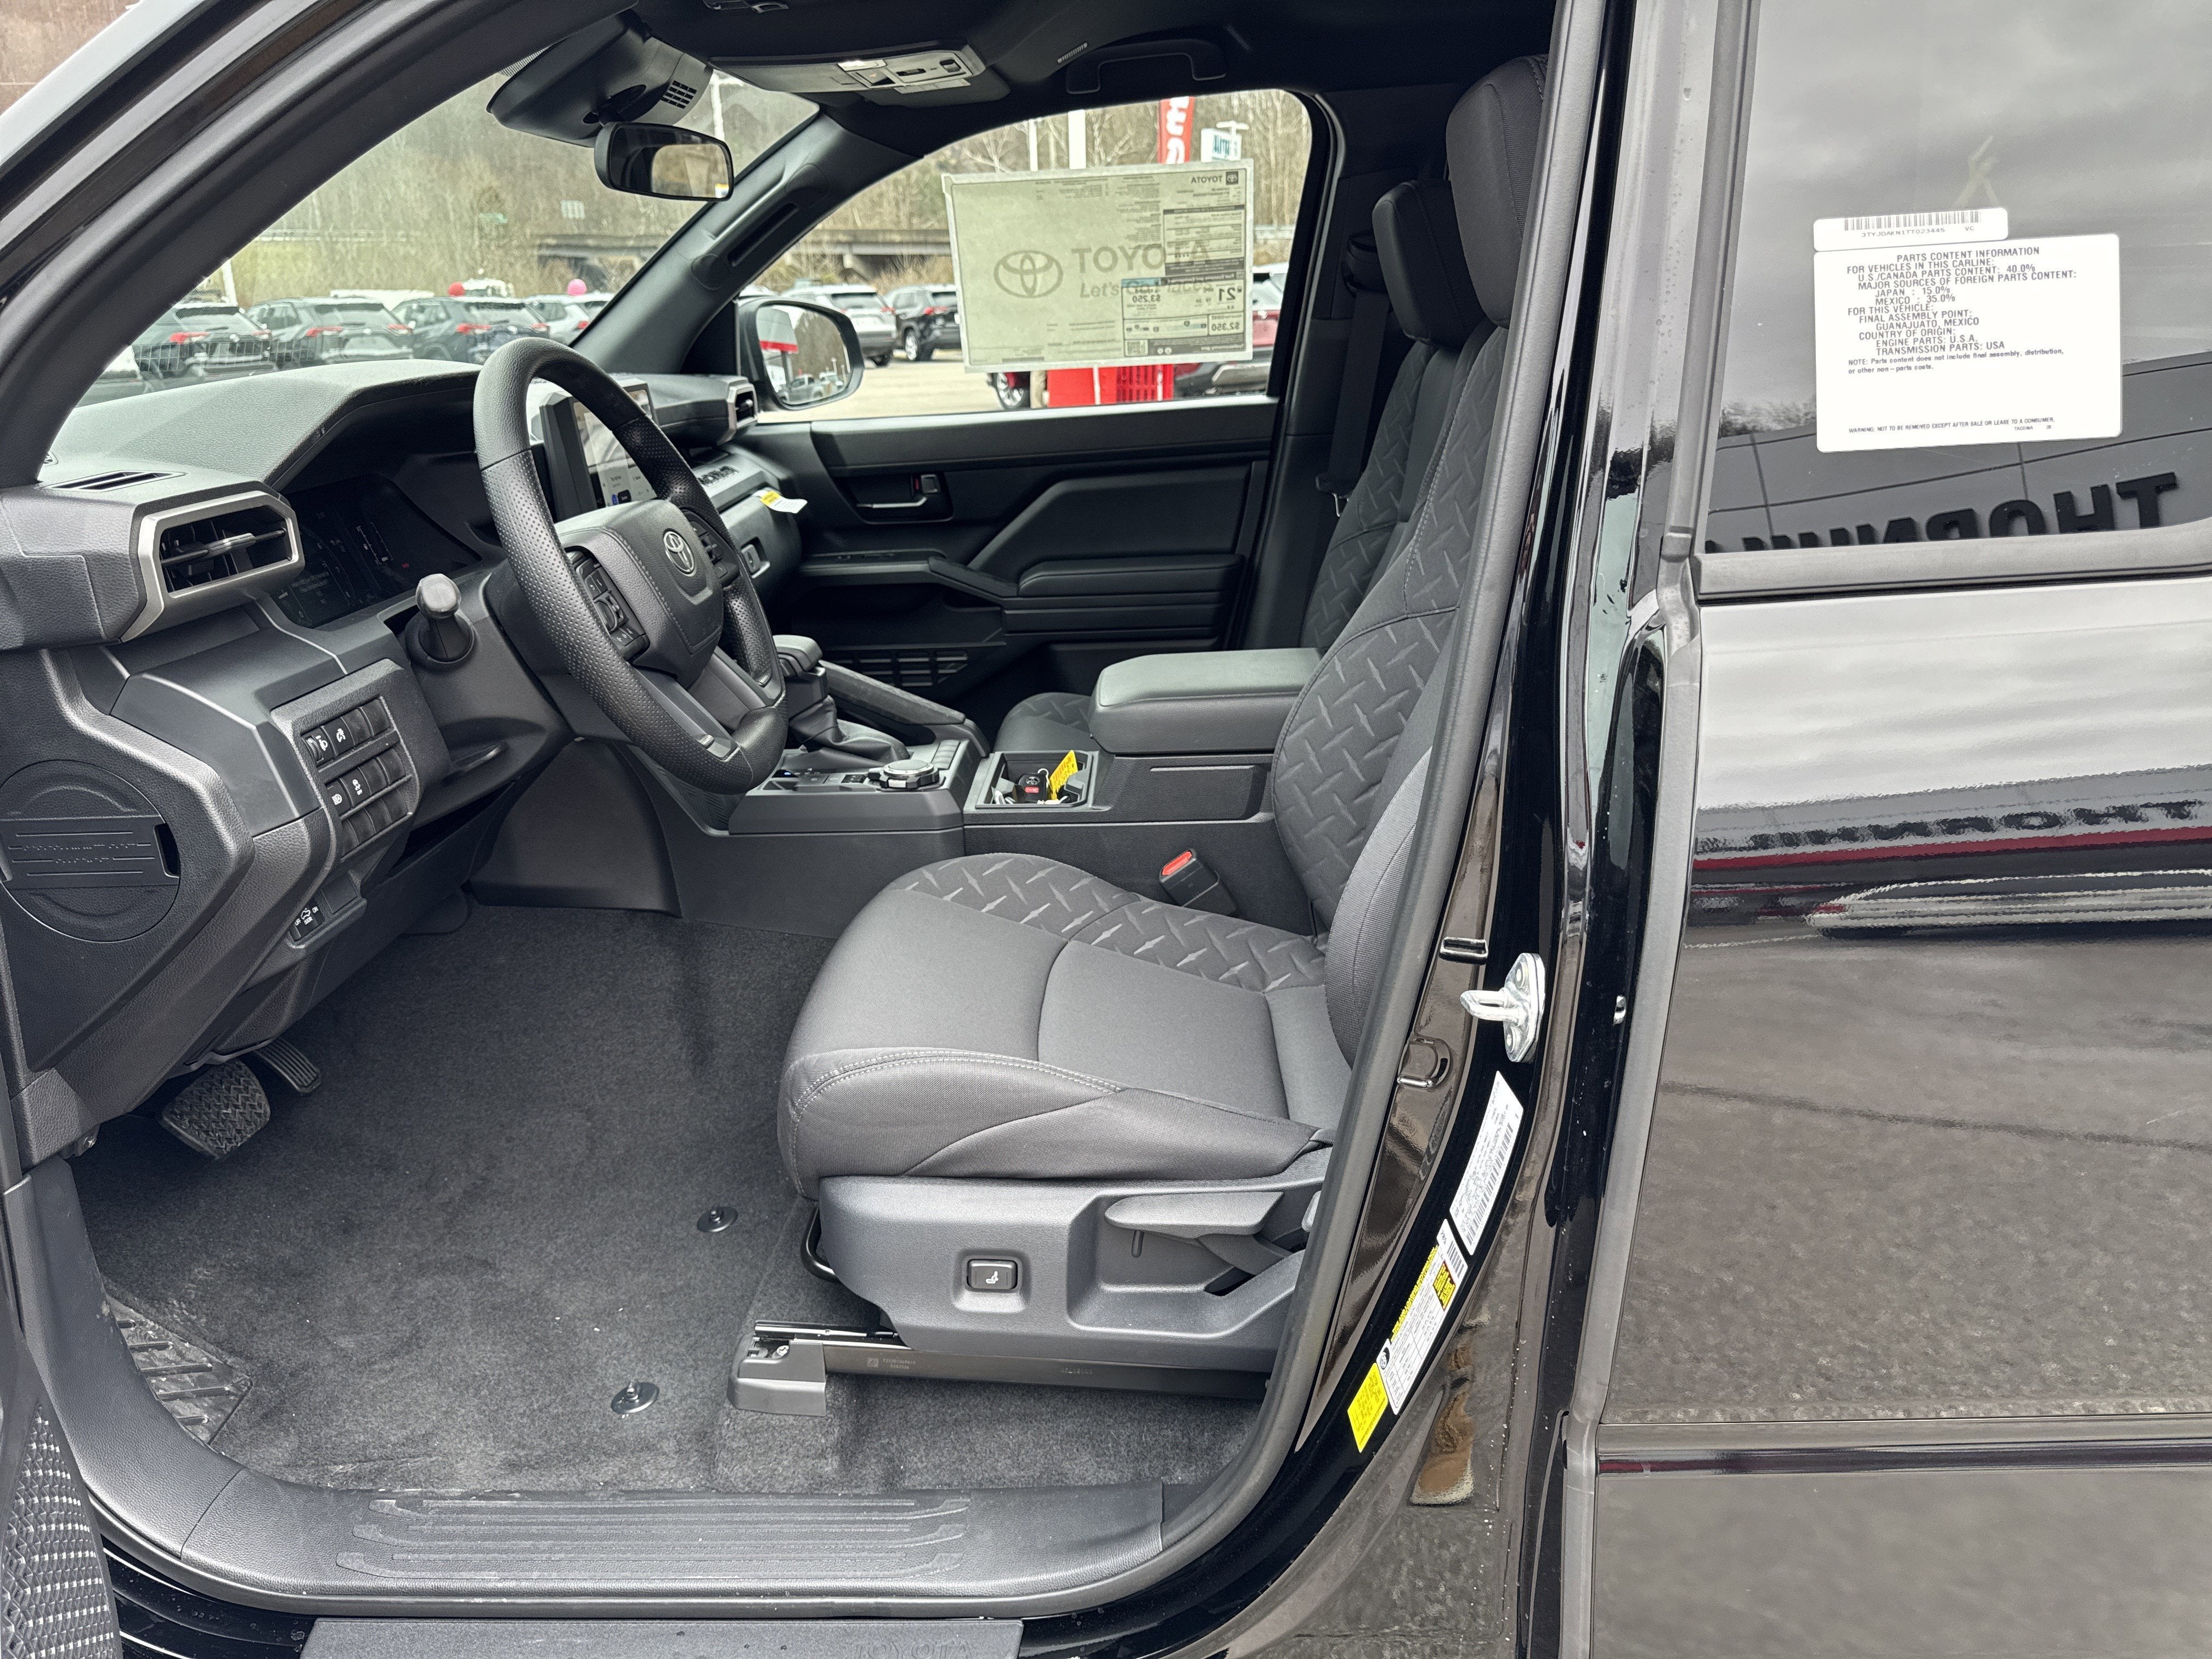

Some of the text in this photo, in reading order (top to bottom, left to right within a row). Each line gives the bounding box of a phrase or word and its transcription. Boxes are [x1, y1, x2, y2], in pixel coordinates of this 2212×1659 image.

[1897, 247, 2040, 262] PARTS CONTENT INFORMATION
[1847, 258, 1994, 274] FOR VEHICLES IN THIS CARLINE:
[1858, 264, 2036, 282] U.S./CANADA PARTS CONTENT: 40.0%
[1858, 270, 2076, 290] MAJOR SOURCES OF FOREIGN PARTS CONTENT:
[1079, 281, 1120, 298] Let's
[1875, 288, 1905, 298] JAPAN
[1922, 286, 1950, 295] 15.0%
[1875, 296, 1910, 306] MEXICO
[1926, 294, 1955, 303] 35.0%
[1848, 303, 1934, 316] FOR THIS VEHICLE:
[1859, 309, 1972, 324] FINAL ASSEMBLY POINT:
[1876, 317, 1979, 331] GUANAJUATO, MEXICO
[1859, 327, 1956, 341] COUNTRY OF ORIGIN:
[1876, 334, 1978, 347] ENGINE PARTS: U.S.A.
[1876, 341, 2005, 356] TRANSMISSION PARTS: USA
